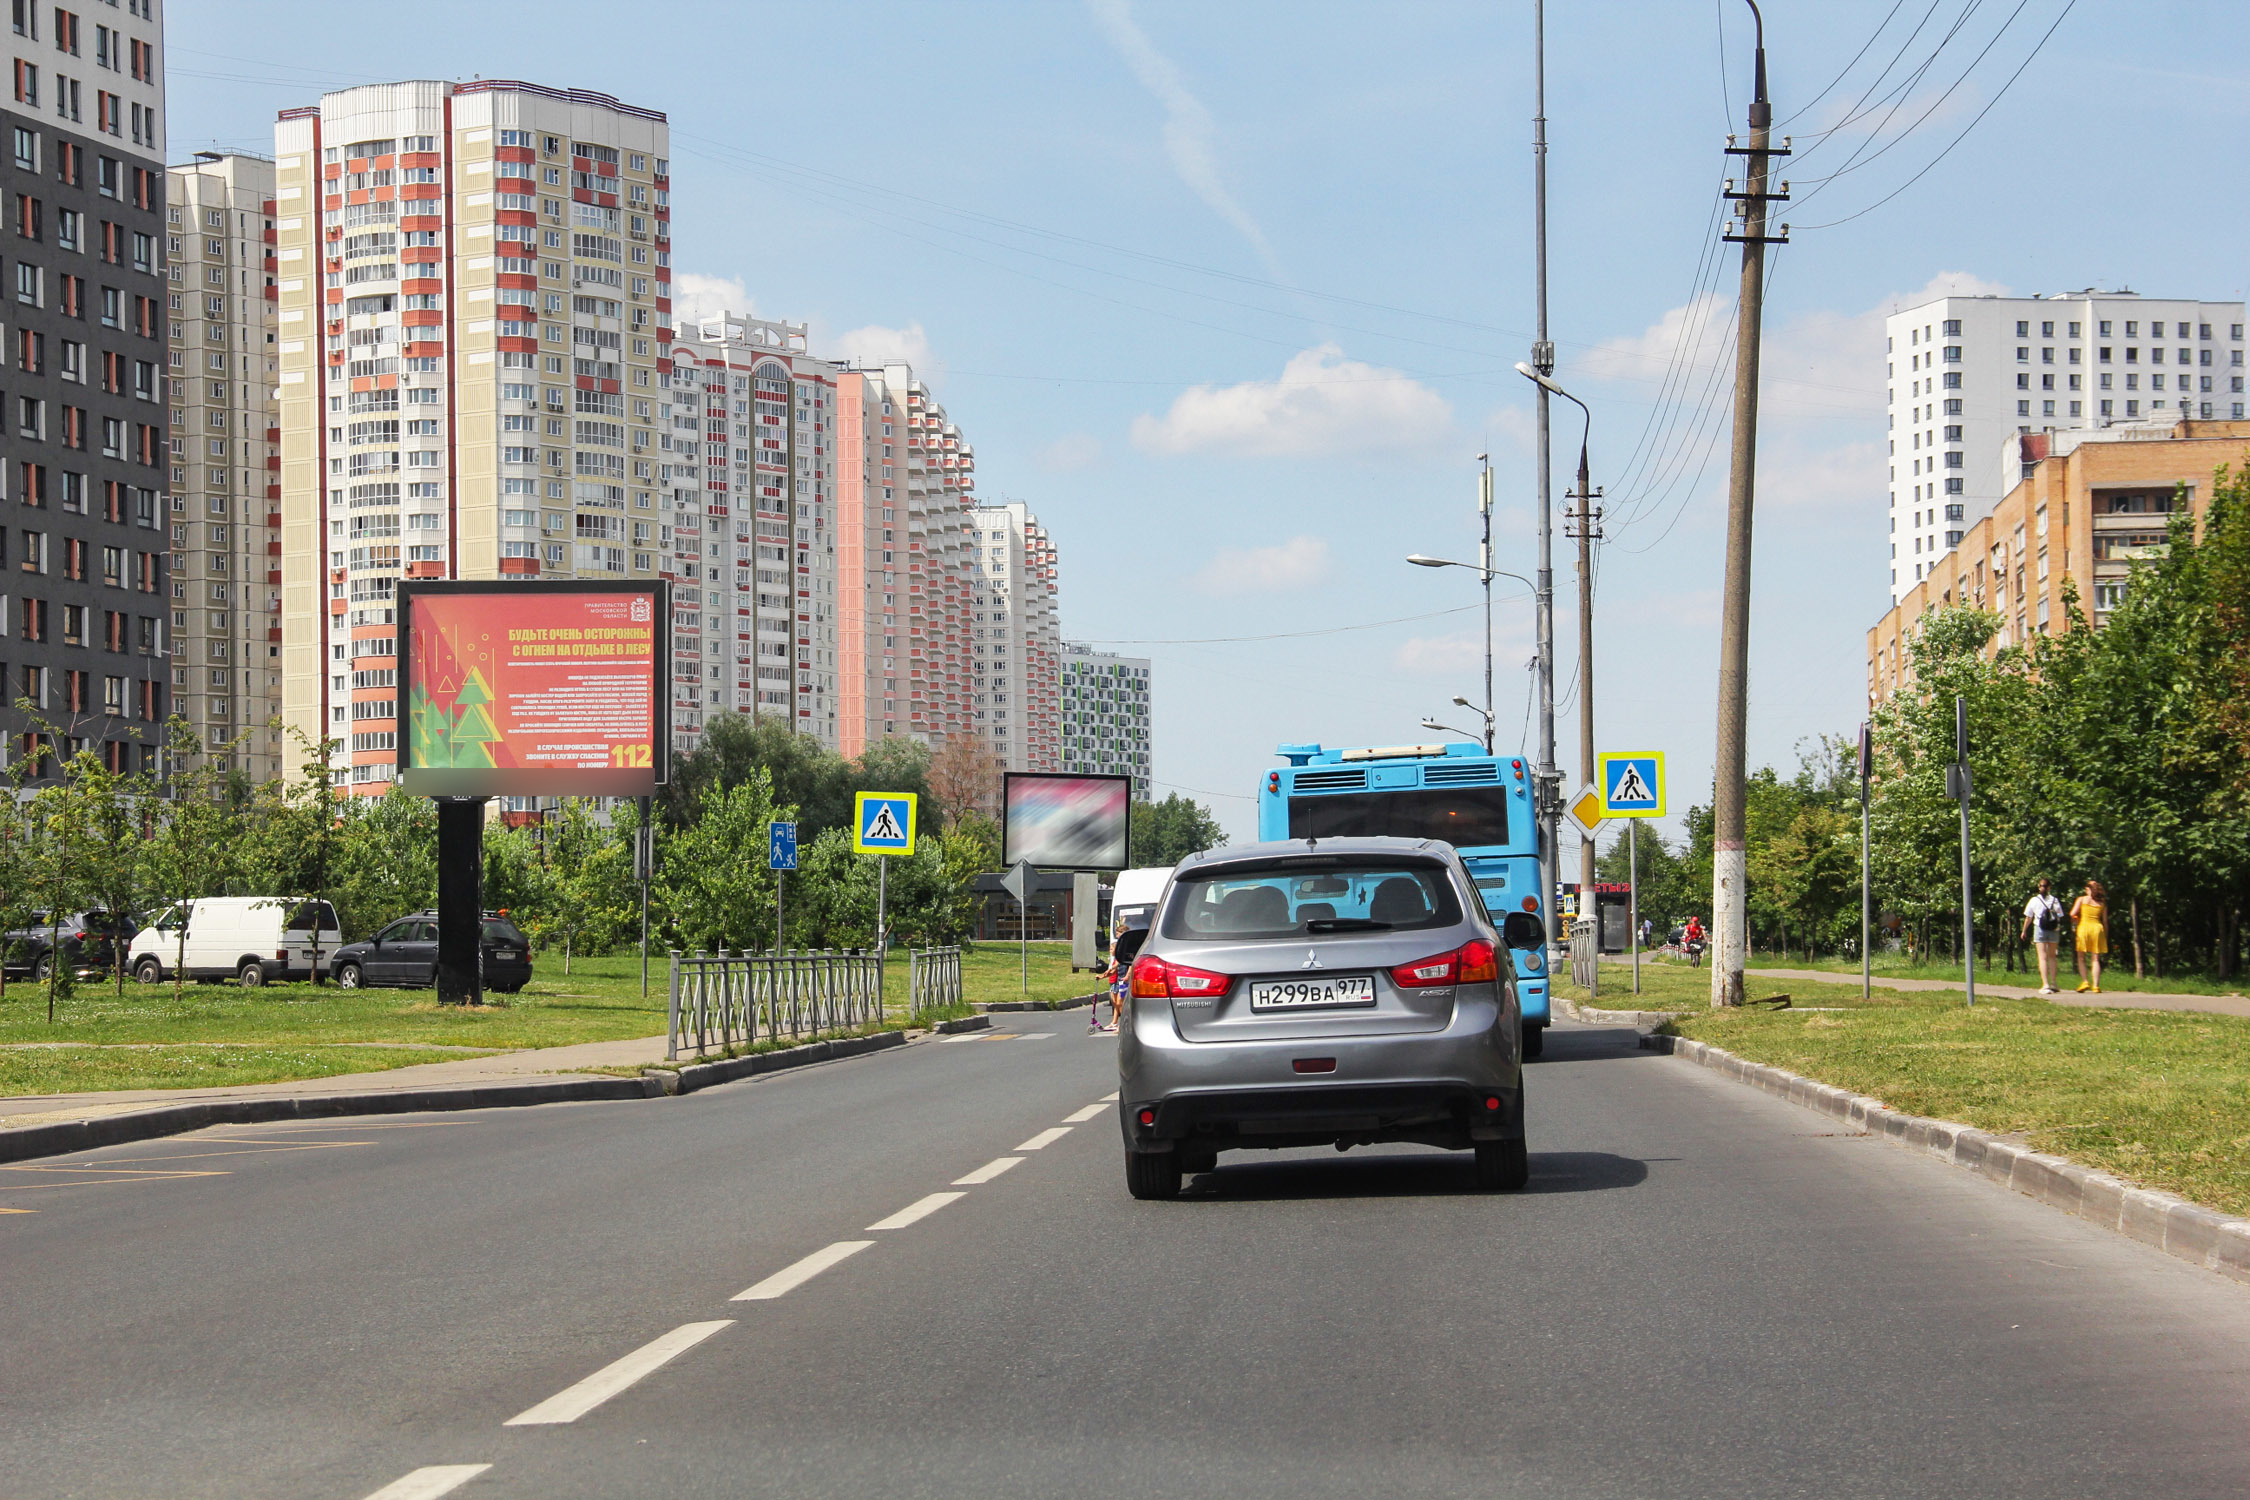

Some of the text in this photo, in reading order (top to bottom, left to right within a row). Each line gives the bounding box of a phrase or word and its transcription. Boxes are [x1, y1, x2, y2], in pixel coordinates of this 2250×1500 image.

[508, 627, 651, 642] БУДЬТЕ ОЧЕНЬ ОСТОРОЖНЫ
[512, 643, 651, 657] С ОГНЕМ НА ОТДЫХЕ В ЛЕСУ
[611, 743, 653, 768] 112
[1258, 979, 1368, 1005] Н299ВА 977
[1419, 989, 1451, 997] ASX
